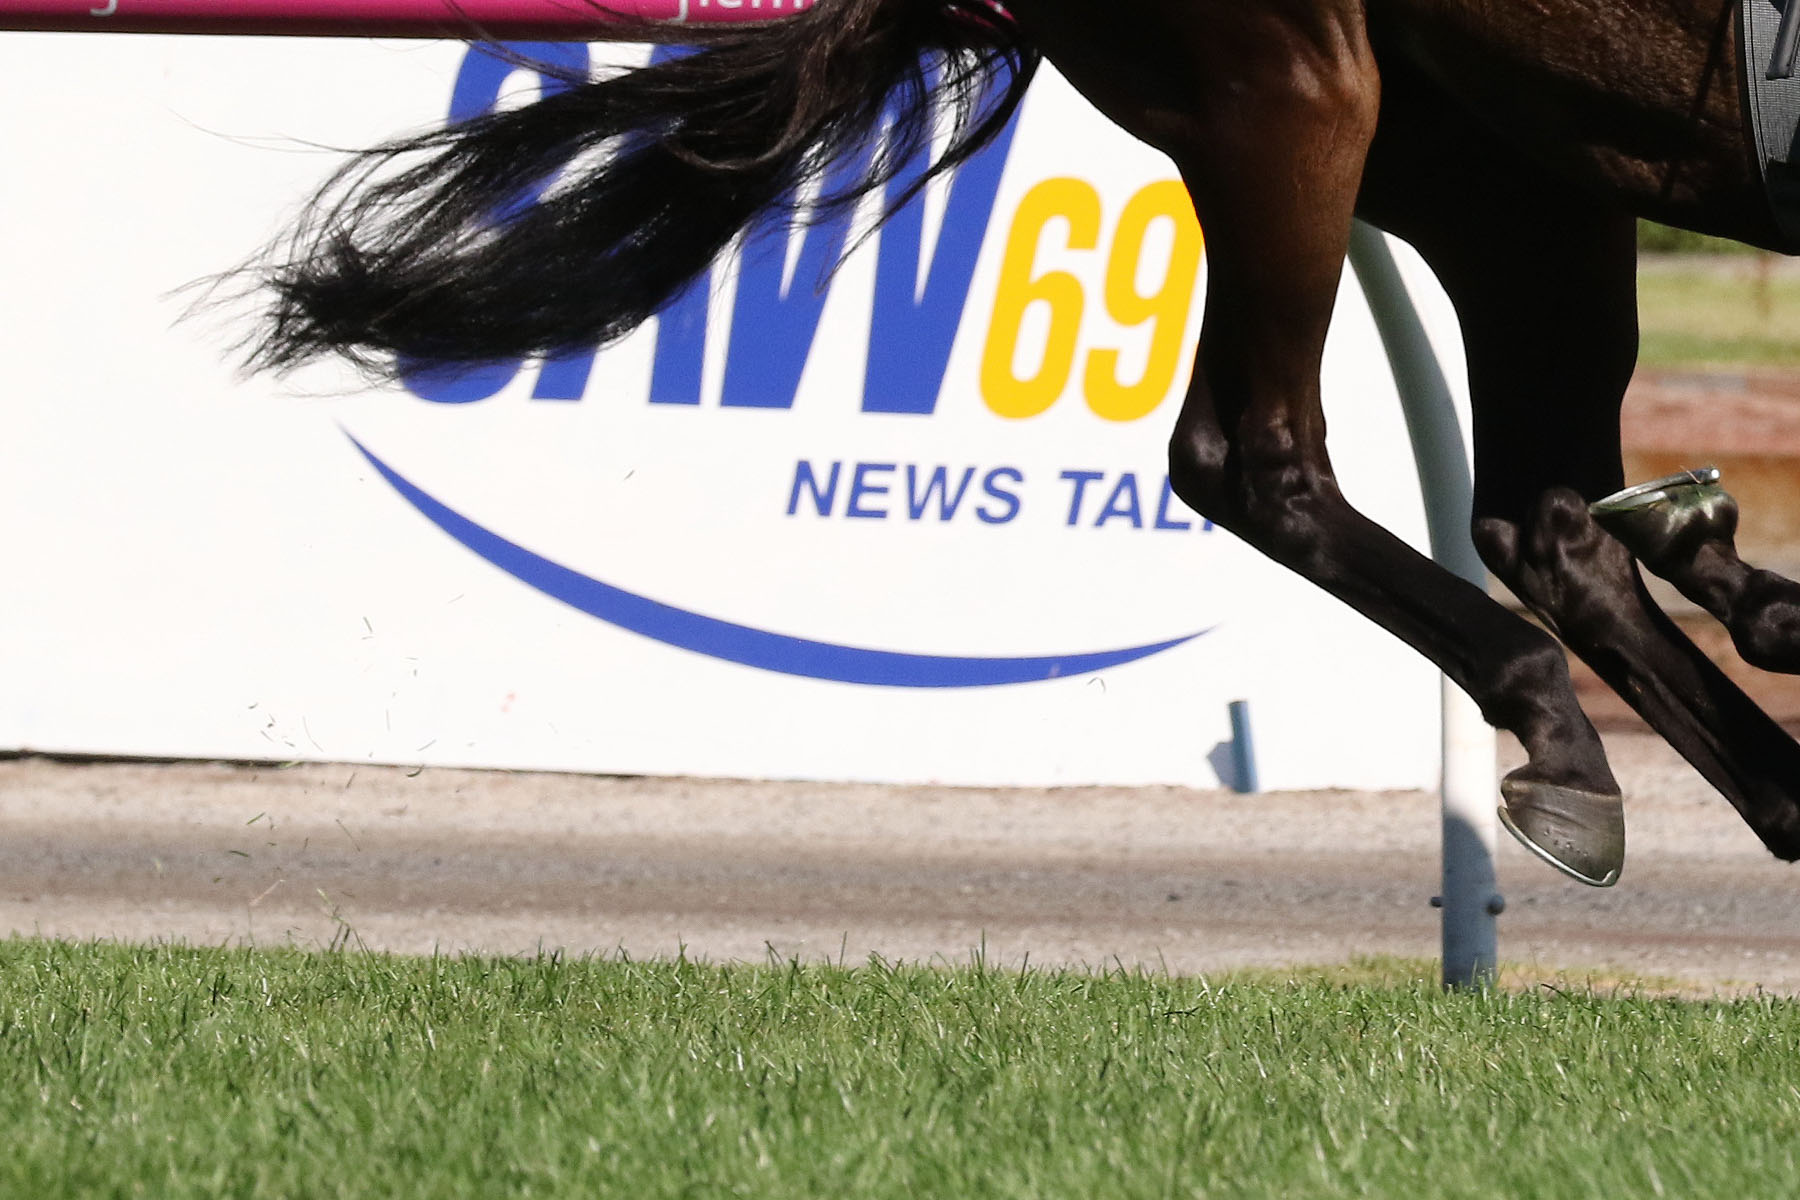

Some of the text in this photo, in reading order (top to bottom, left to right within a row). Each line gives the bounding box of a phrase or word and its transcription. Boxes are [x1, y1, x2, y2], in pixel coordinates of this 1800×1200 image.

[979, 175, 1207, 423] 69
[786, 459, 1214, 532] NEWS TAL
